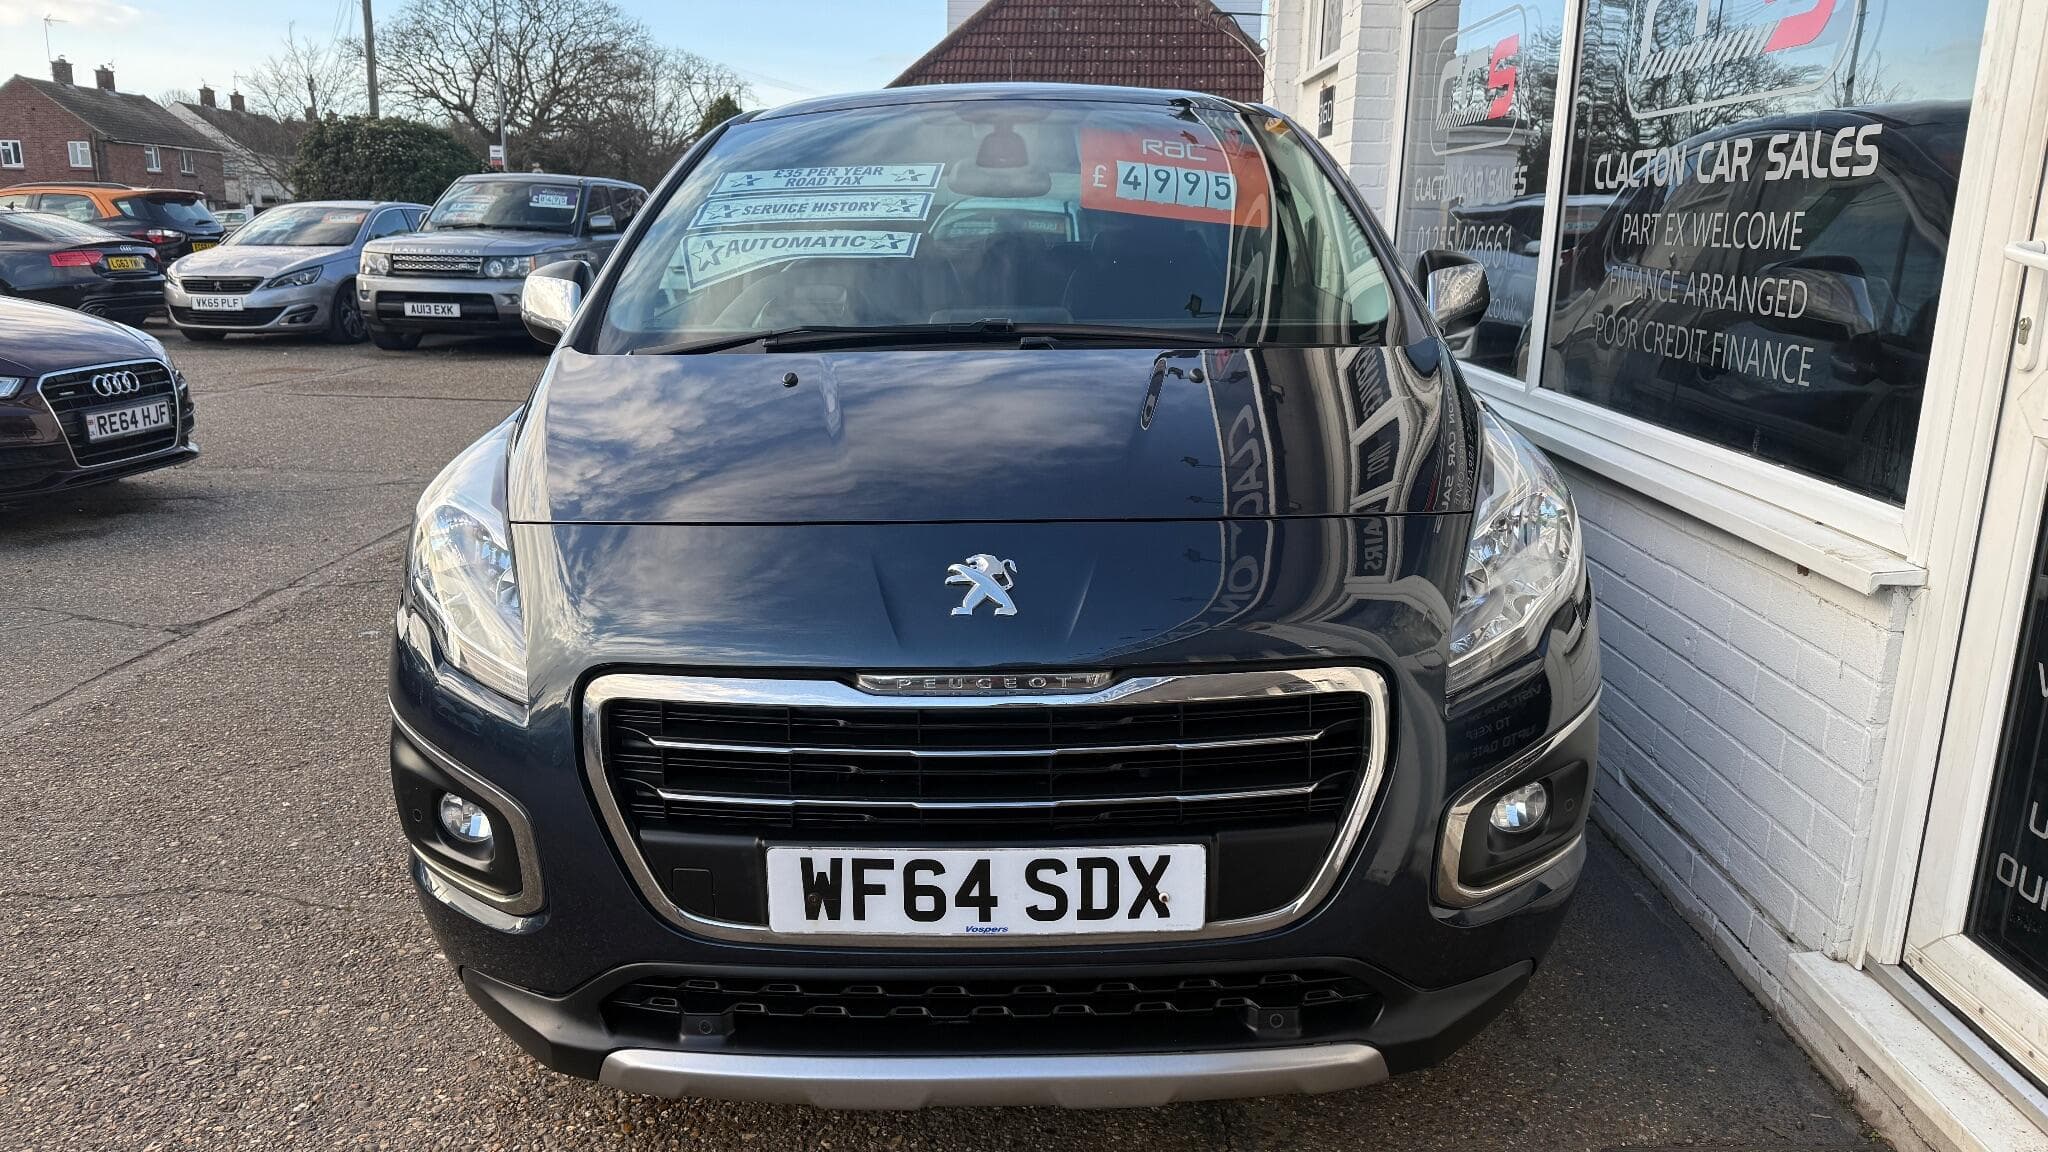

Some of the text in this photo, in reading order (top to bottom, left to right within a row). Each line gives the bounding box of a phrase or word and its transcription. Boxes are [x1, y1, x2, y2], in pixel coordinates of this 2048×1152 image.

[1595, 124, 1883, 190] CLACTON CAR SALES
[773, 166, 884, 178] £35 PER YEAR
[785, 176, 864, 187] ROAD TAX
[1122, 166, 1232, 201] 4995
[742, 201, 881, 216] SERVICE HISTORY
[1621, 211, 1805, 250] PART EX WELCOME
[724, 235, 867, 258] AUTOMATIC
[196, 298, 239, 308] VK65 PLF
[1609, 266, 1808, 319] FINANCE ARRANGED
[411, 303, 454, 315] AU13 EXK
[1595, 313, 1814, 386] POOR CREDIT FINANCE
[96, 404, 166, 436] RE64 HJF
[896, 677, 1072, 689] PEUGEOT
[800, 854, 1171, 922] WF64 SDX
[965, 925, 1009, 934] Vospers
